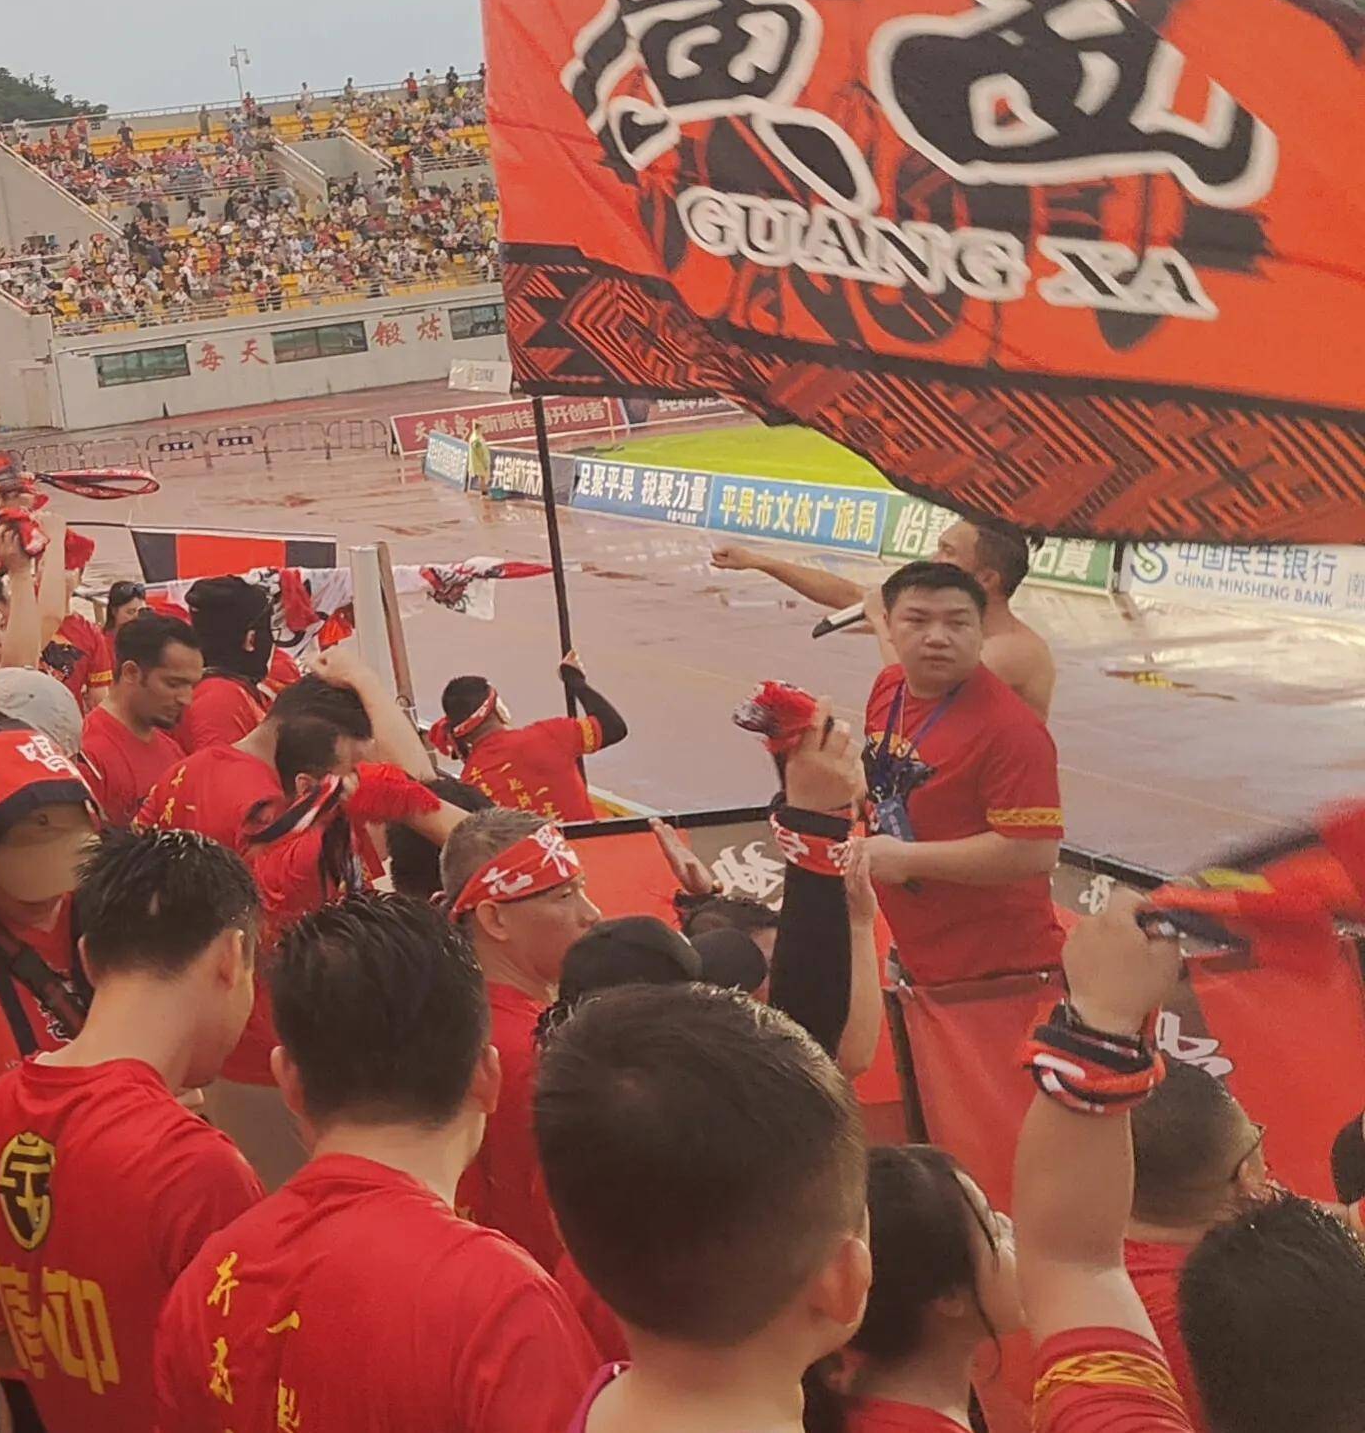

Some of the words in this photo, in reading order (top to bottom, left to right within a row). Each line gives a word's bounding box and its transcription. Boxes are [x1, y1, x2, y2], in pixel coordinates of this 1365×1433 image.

[675, 184, 1032, 303] GUANG
[196, 339, 268, 371] 每天
[641, 470, 707, 511] 税聚力量
[719, 484, 878, 545] 平果市文体广旅局
[1176, 541, 1337, 586] 中国民生银行
[1174, 571, 1215, 589] CHINA
[1219, 578, 1290, 600] MINSHENG
[1295, 588, 1334, 607] BANK
